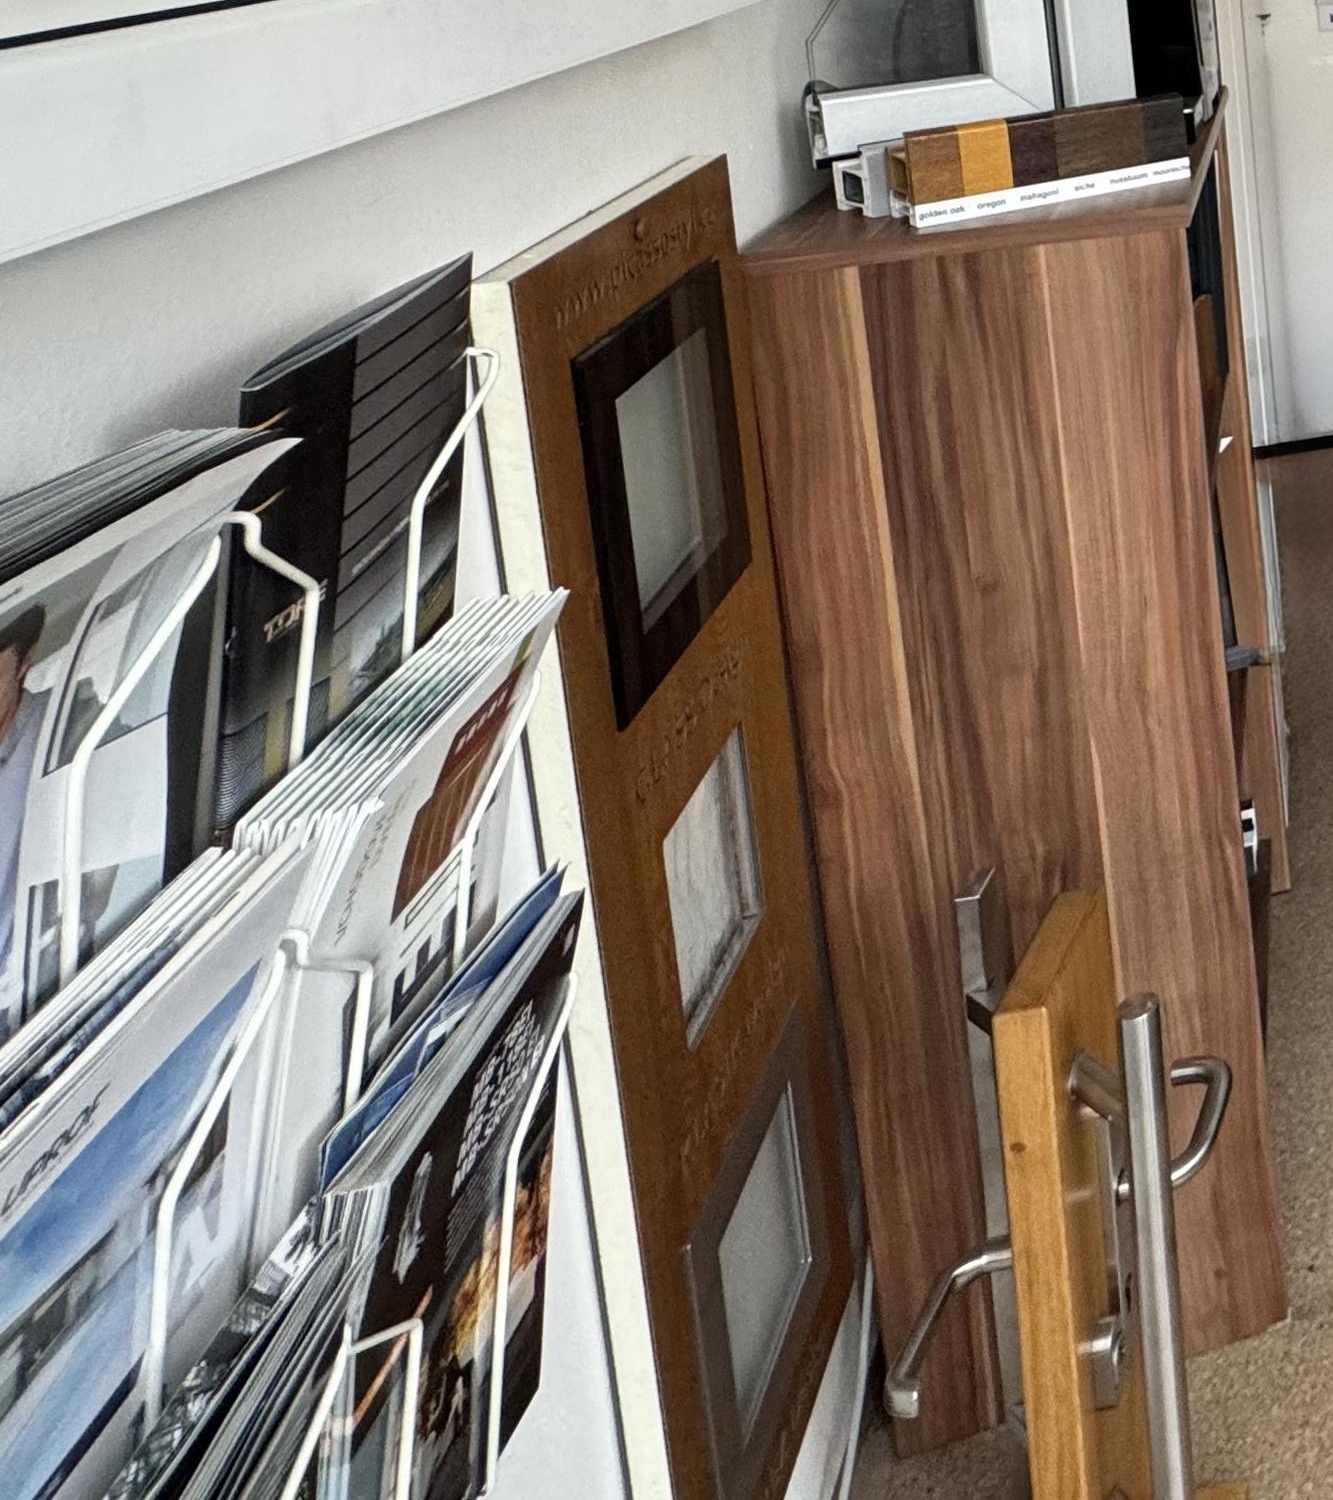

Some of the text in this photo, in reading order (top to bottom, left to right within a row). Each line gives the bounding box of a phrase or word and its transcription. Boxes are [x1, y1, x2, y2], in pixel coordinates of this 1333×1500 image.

[919, 208, 948, 221] golden
[950, 205, 965, 215] oak
[976, 199, 1007, 210] oregon
